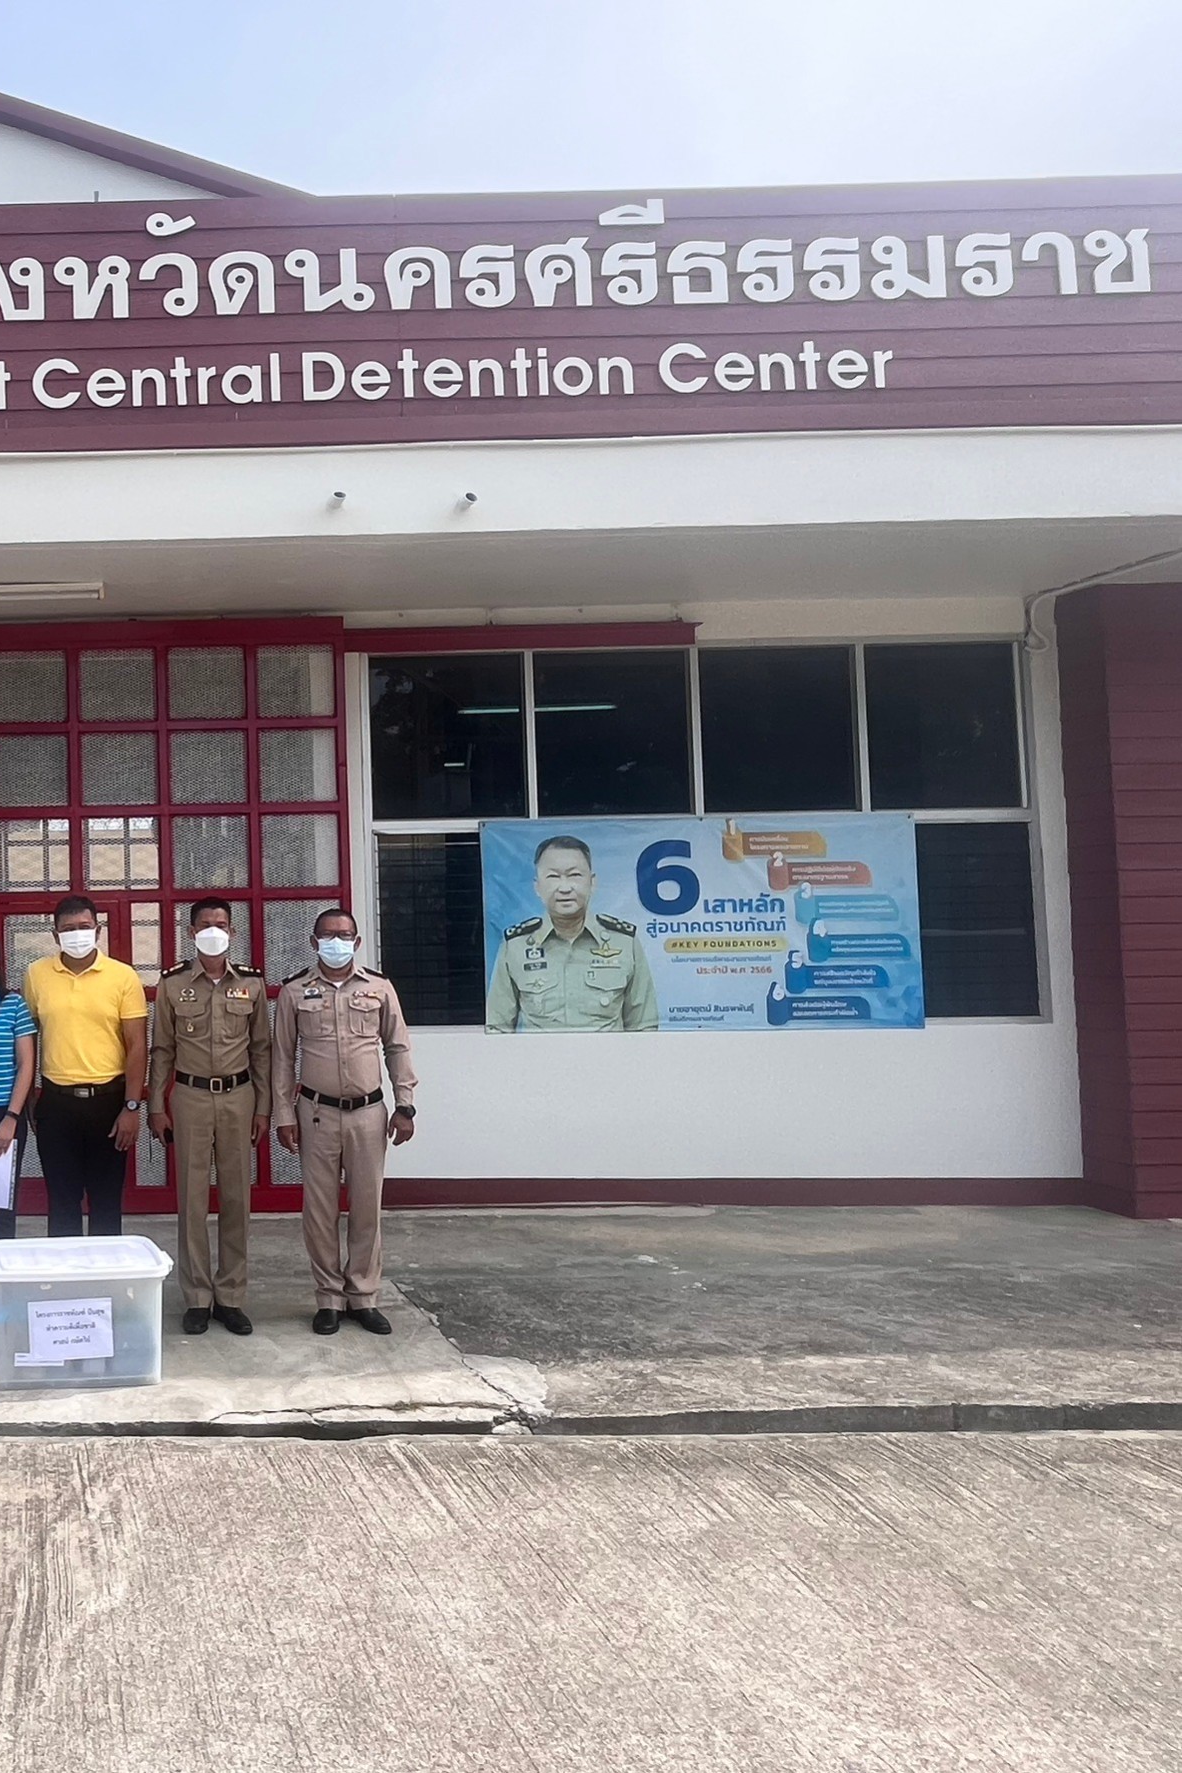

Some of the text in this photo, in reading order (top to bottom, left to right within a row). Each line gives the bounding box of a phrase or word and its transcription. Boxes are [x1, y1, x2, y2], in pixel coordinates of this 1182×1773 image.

[31, 352, 282, 411] Central
[302, 347, 636, 402] Detention
[657, 341, 895, 394] Center
[773, 852, 784, 867] 2
[636, 839, 700, 916] 6
[801, 882, 812, 899] 3
[703, 893, 785, 914] เสาหลัก
[646, 916, 786, 938] สู่อนาคตราชทัณฑ์
[704, 940, 777, 948] FOUNDATIONS
[792, 952, 803, 968] 5
[750, 966, 773, 974] 2566
[773, 984, 784, 1000] 6
